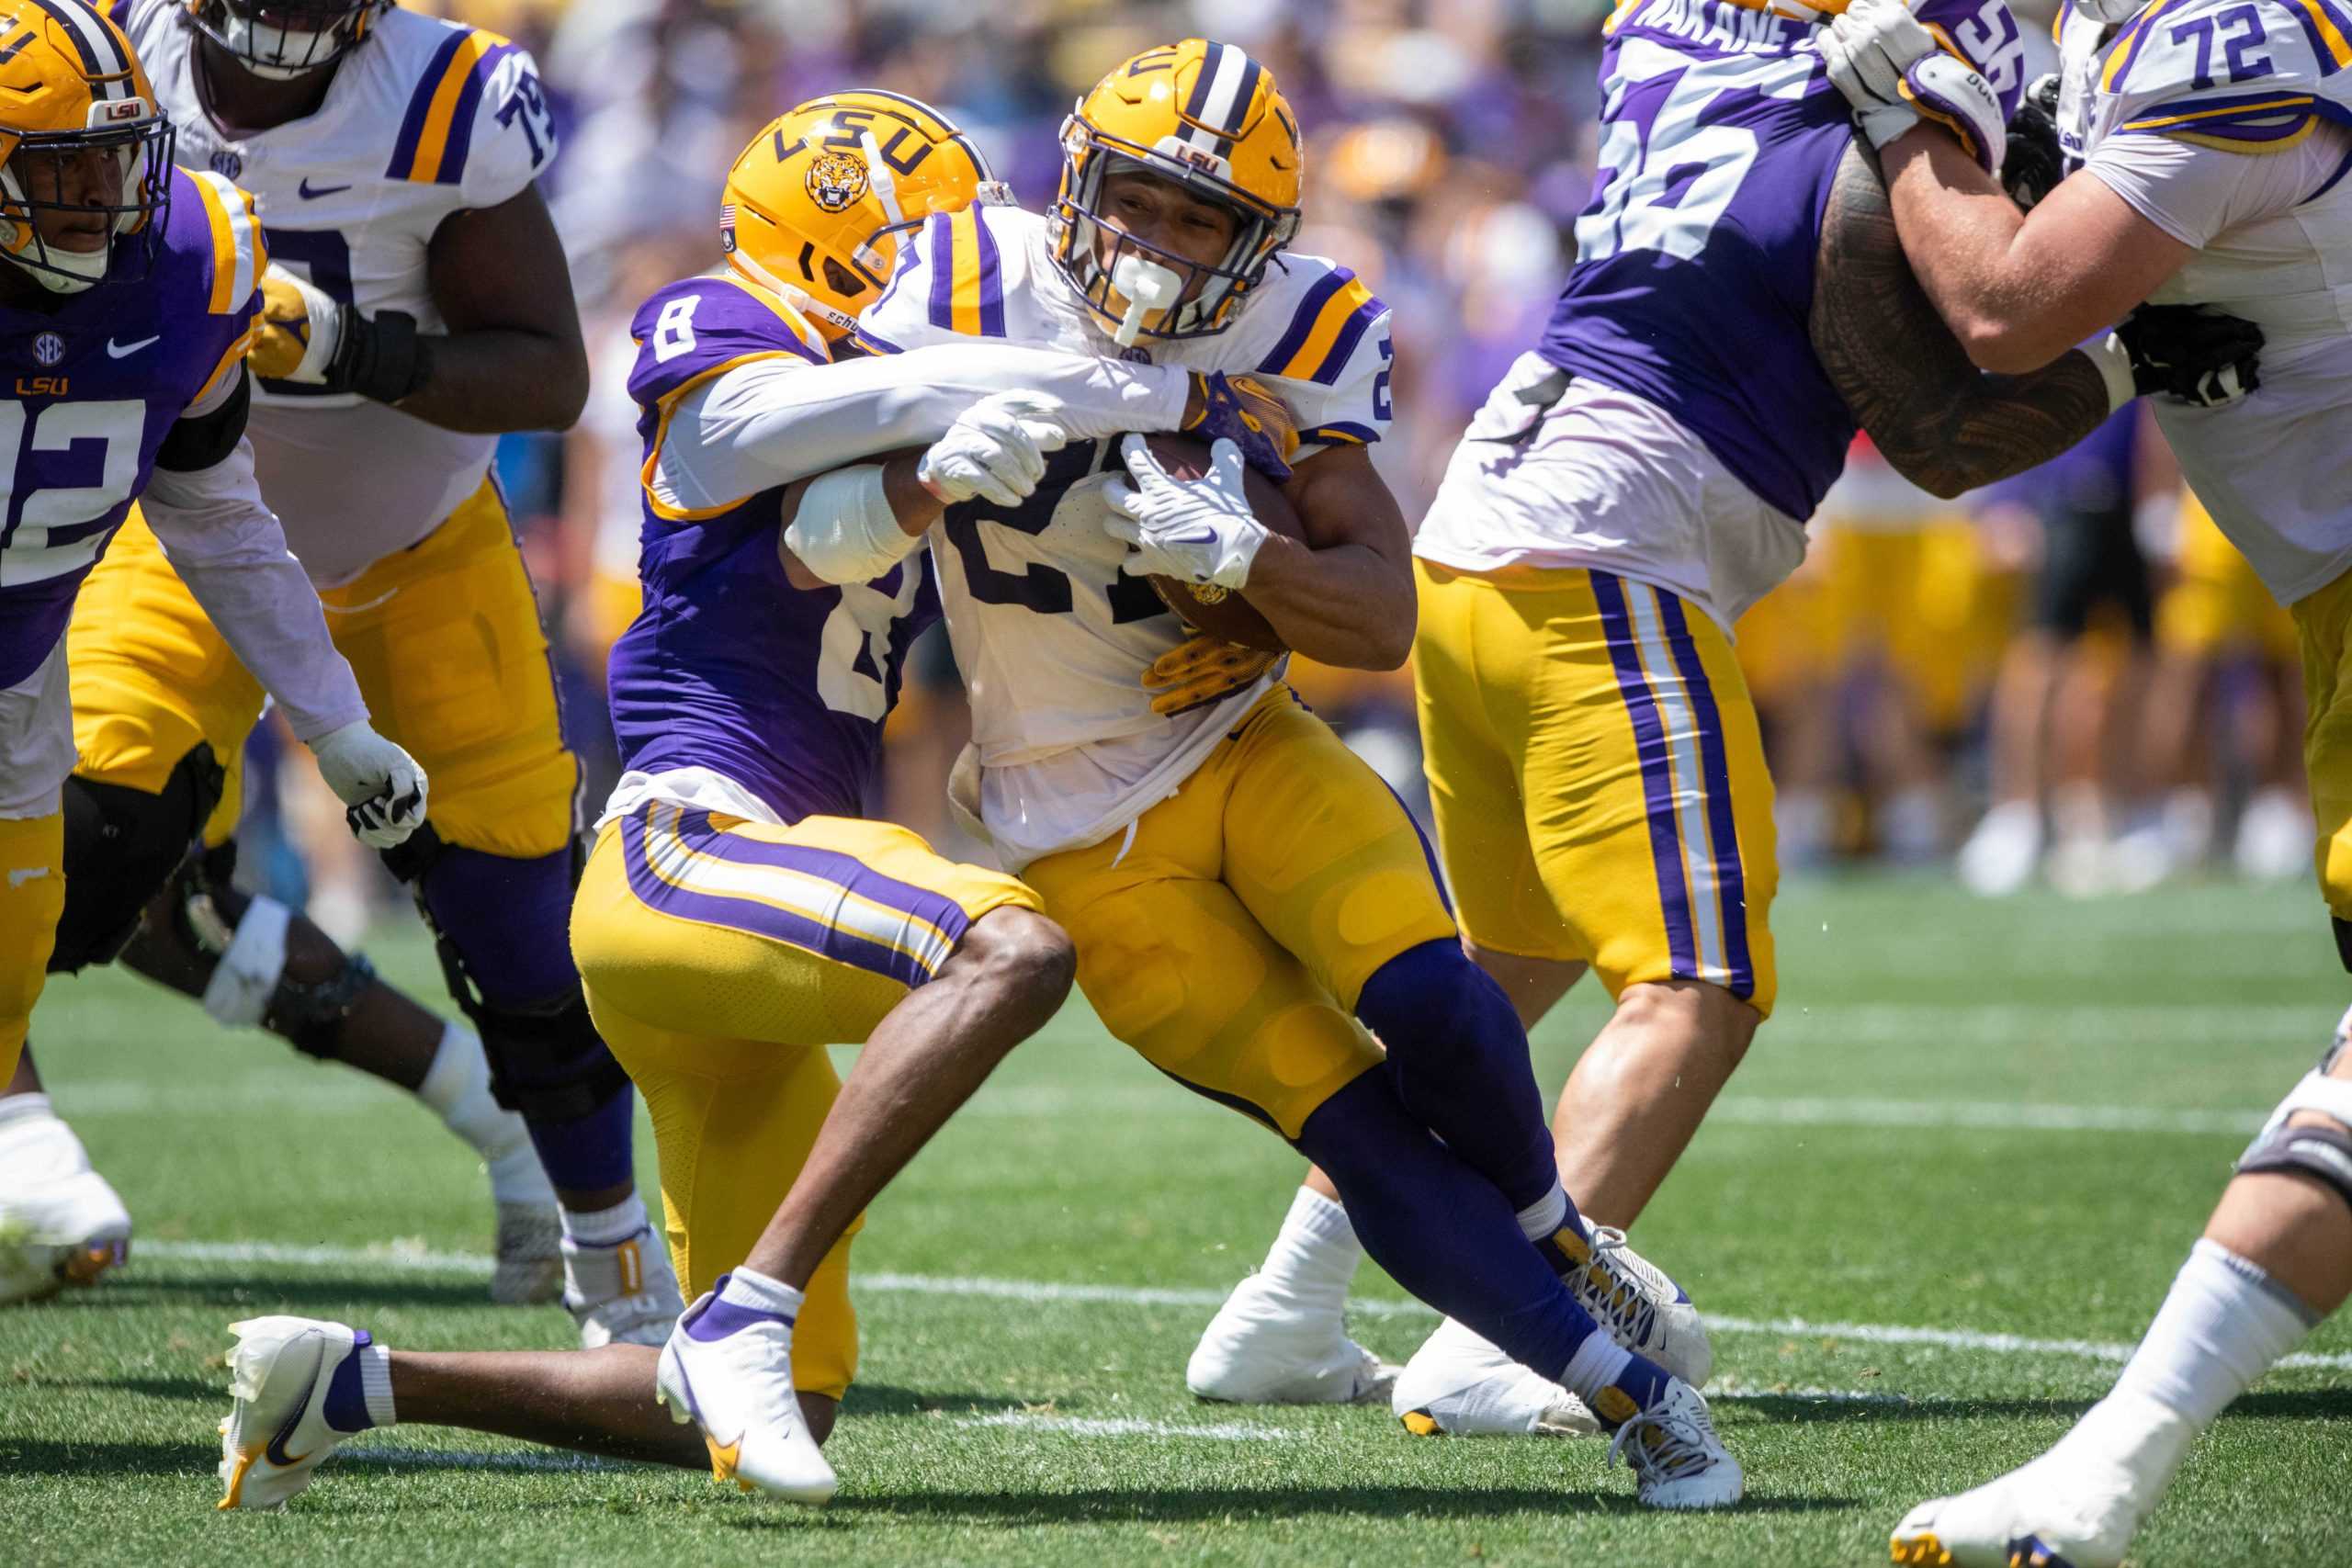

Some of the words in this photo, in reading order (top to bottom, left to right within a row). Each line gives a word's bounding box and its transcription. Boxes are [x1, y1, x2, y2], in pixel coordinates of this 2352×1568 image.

[2170, 3, 2275, 91] 72
[106, 102, 141, 121] LSU
[774, 110, 934, 176] LSU
[1175, 144, 1219, 174] LSU
[1573, 34, 1816, 265] 56
[36, 333, 62, 365] SEC
[652, 294, 703, 365] 8
[15, 376, 70, 397] LSU
[0, 398, 146, 589] 2
